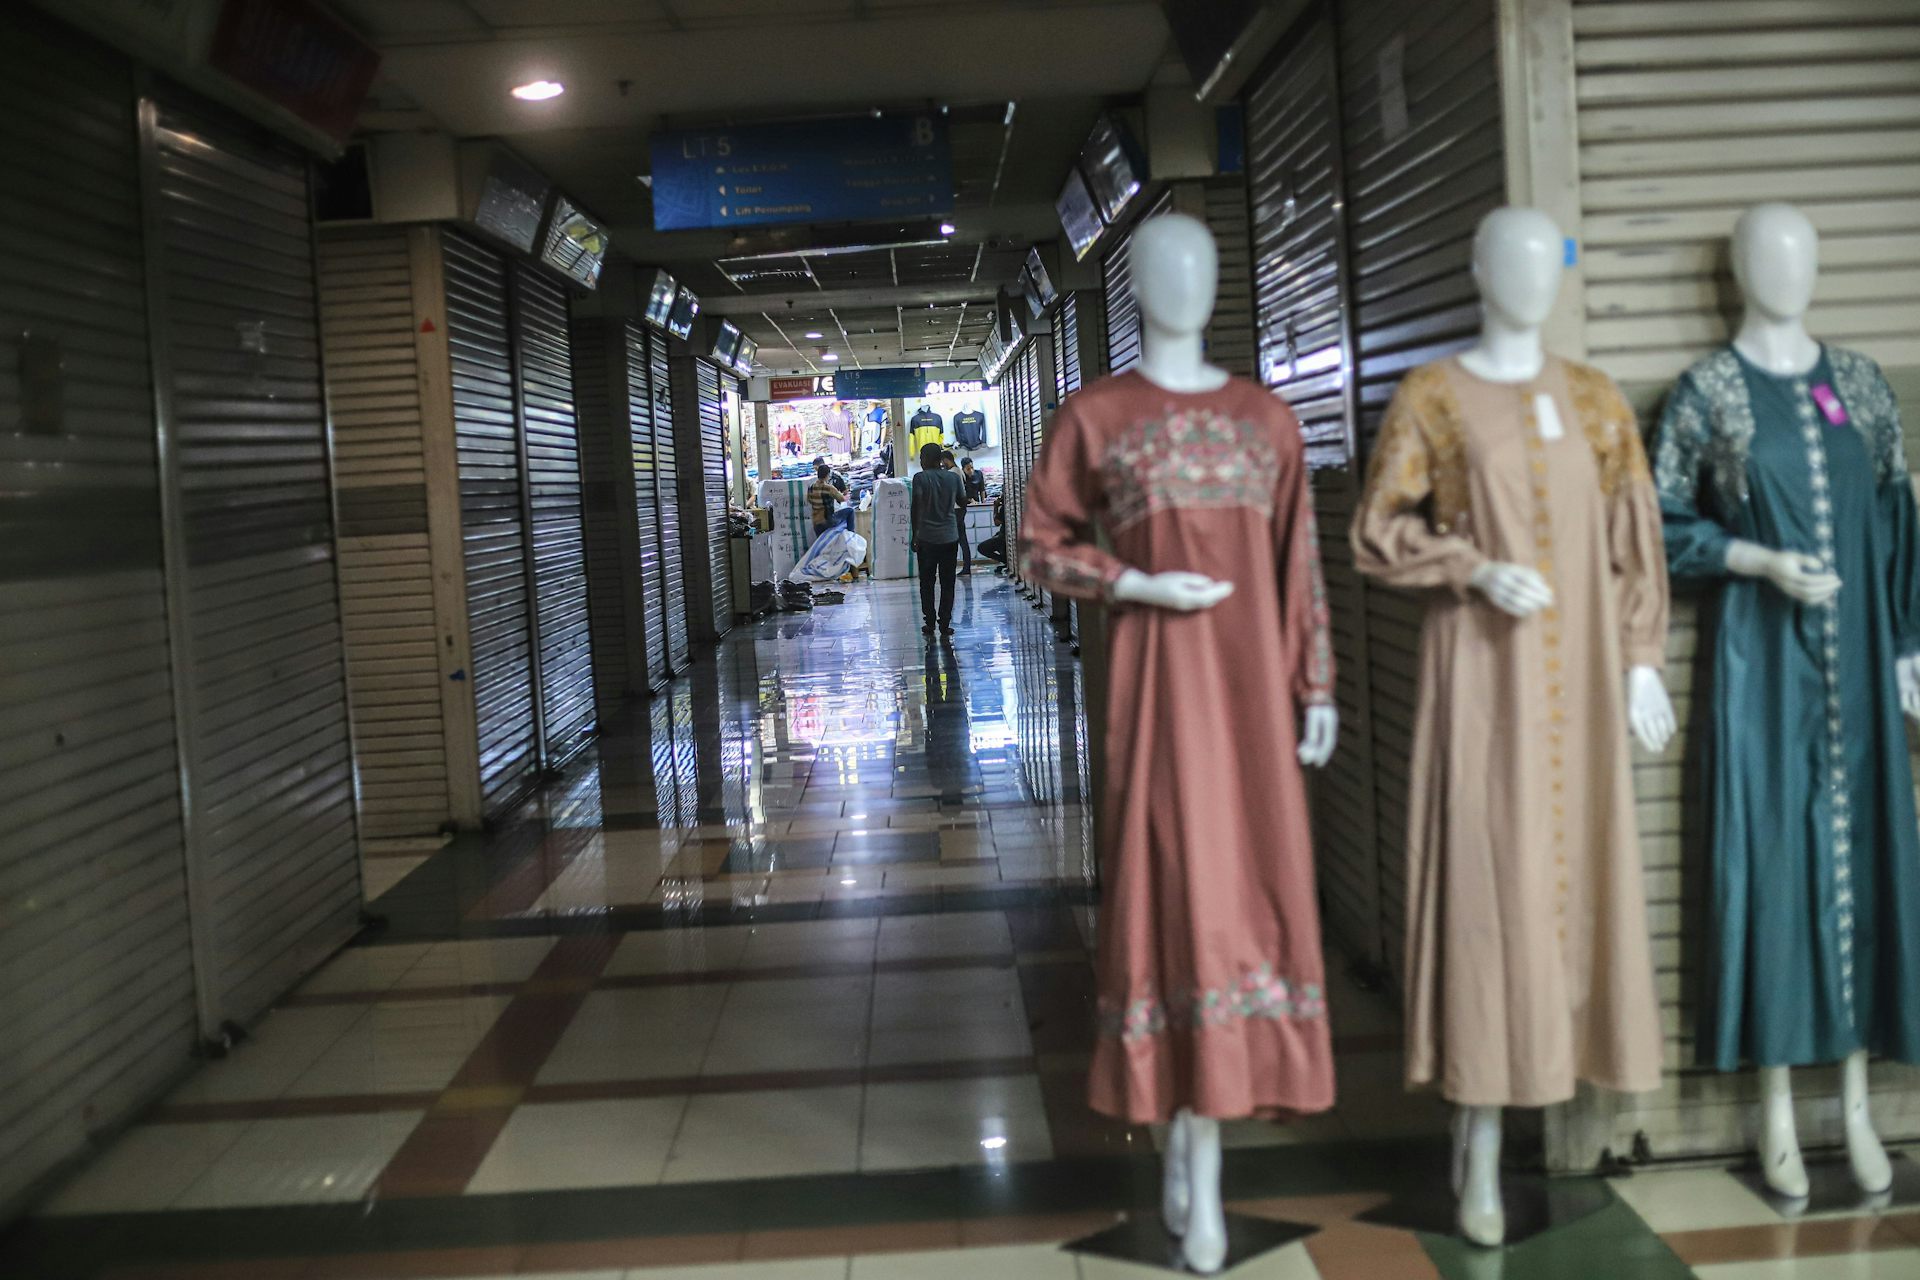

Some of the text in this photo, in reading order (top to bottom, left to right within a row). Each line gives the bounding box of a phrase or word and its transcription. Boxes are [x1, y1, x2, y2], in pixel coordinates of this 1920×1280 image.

[915, 118, 934, 146] B
[682, 136, 731, 159] LT 5
[773, 379, 811, 389] EVAKUASI
